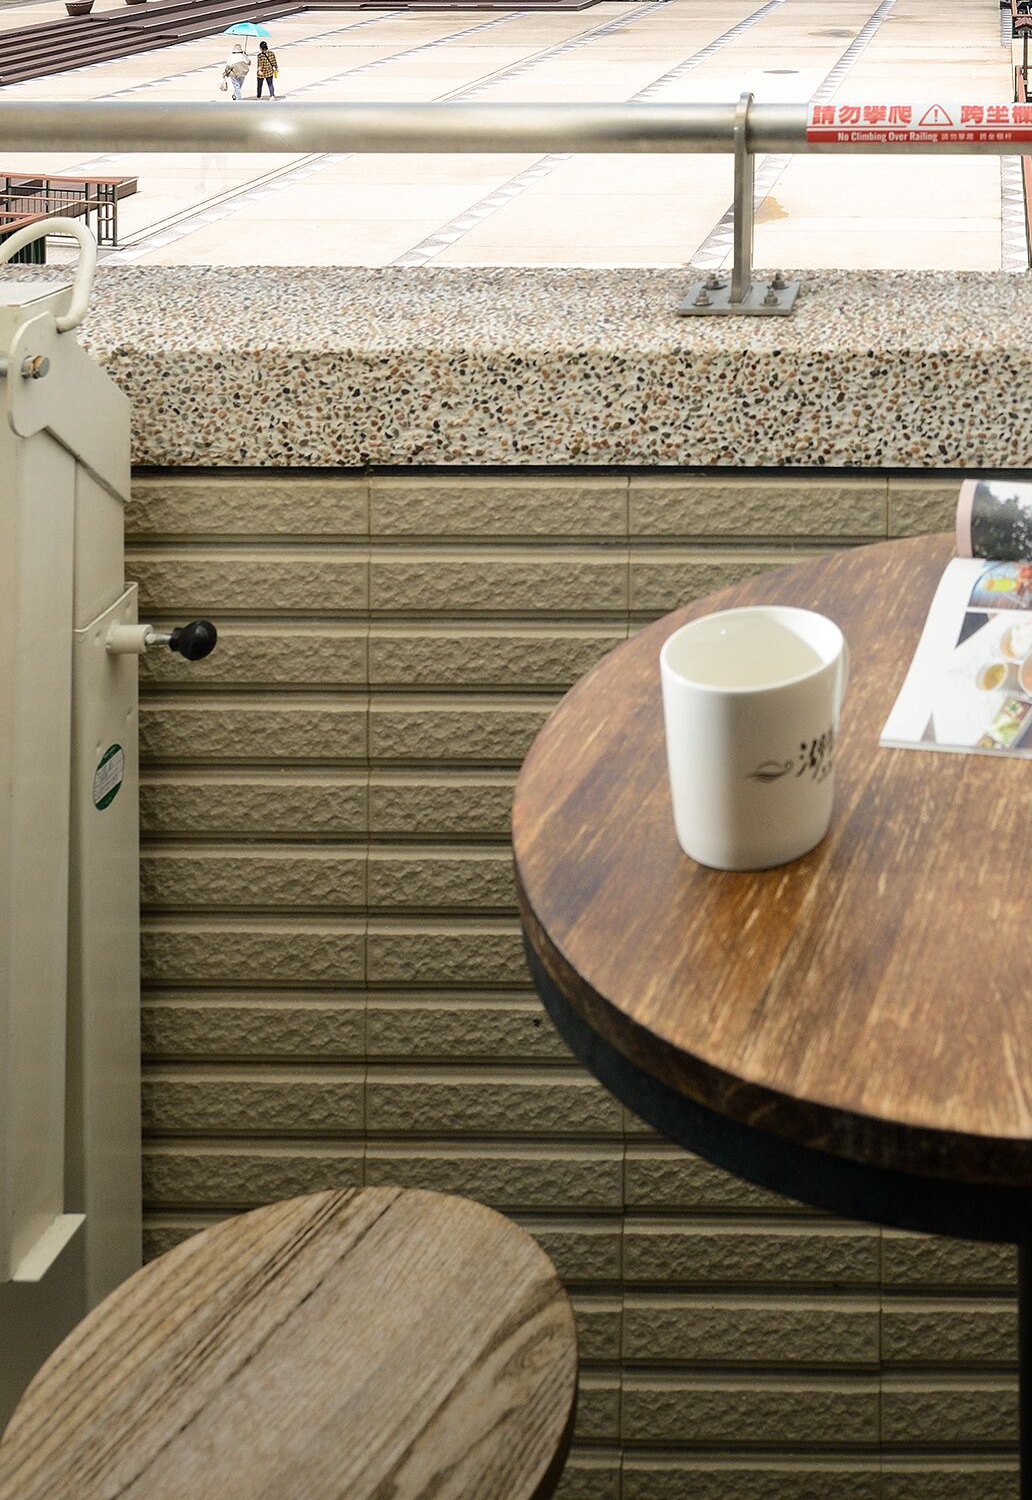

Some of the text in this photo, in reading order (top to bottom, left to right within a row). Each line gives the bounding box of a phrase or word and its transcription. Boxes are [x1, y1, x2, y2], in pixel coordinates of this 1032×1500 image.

[812, 104, 913, 125] 請勿攀爬
[838, 131, 938, 143] No Climbing Over Railing
